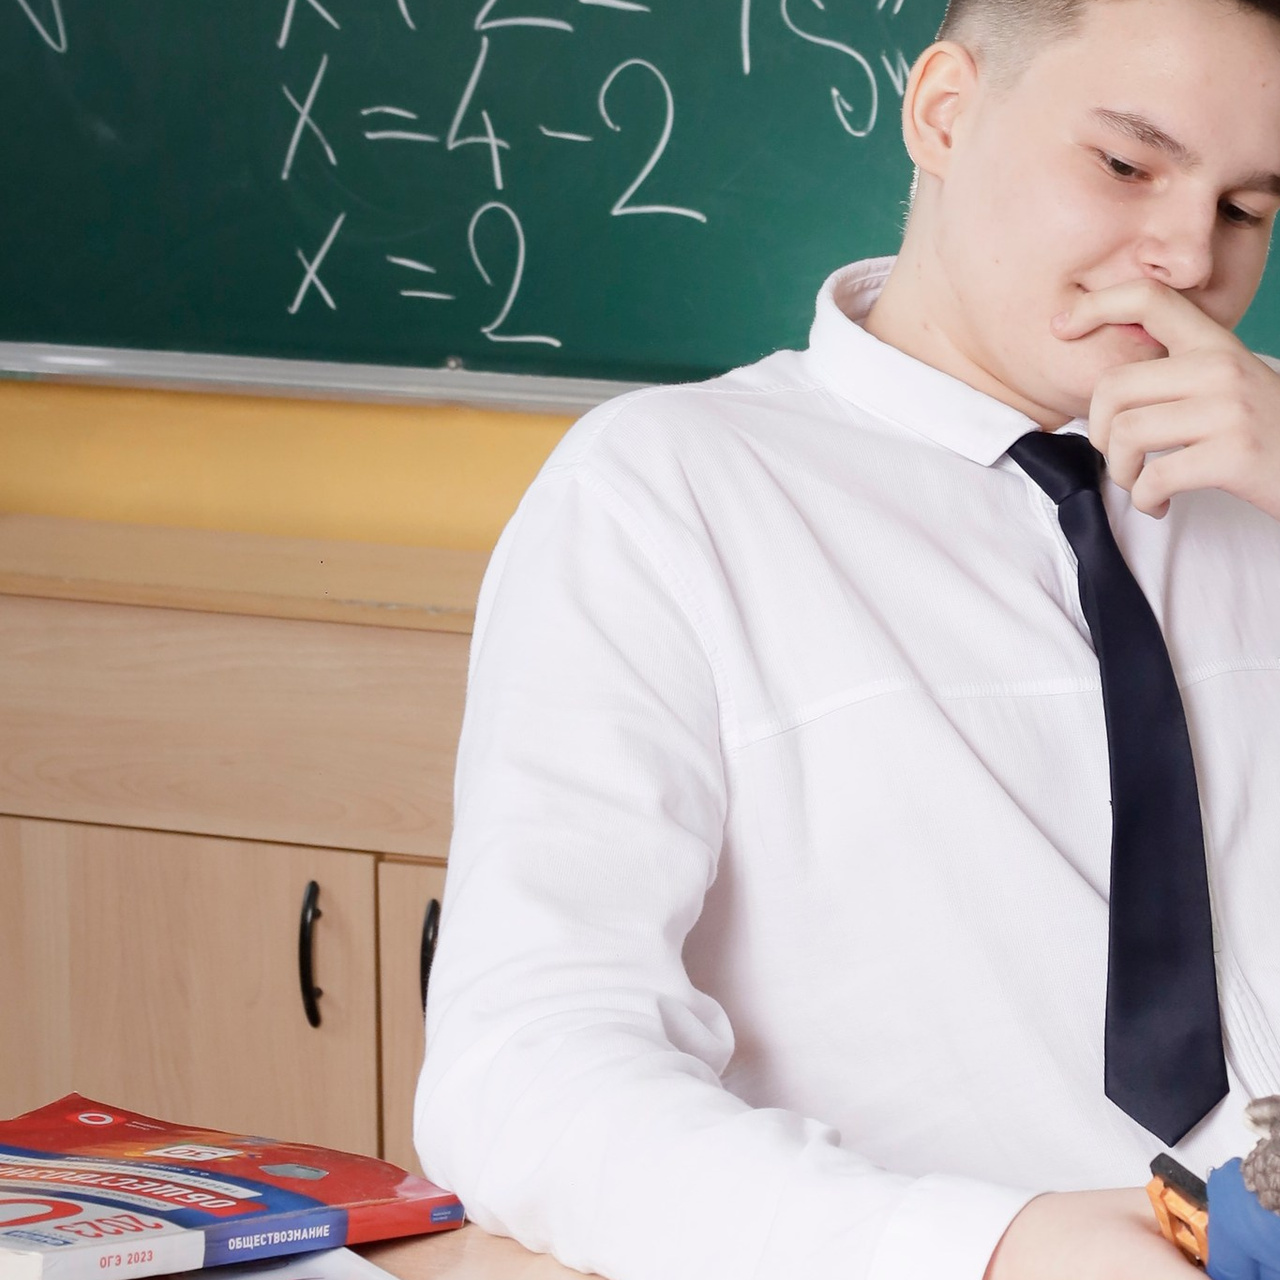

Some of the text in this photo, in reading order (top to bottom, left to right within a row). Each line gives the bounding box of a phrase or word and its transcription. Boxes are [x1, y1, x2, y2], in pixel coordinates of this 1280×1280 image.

[227, 1223, 331, 1251] ОБЩЕСТВОЗНАНИЕ
[99, 1249, 154, 1269] ОГЭ 2023
